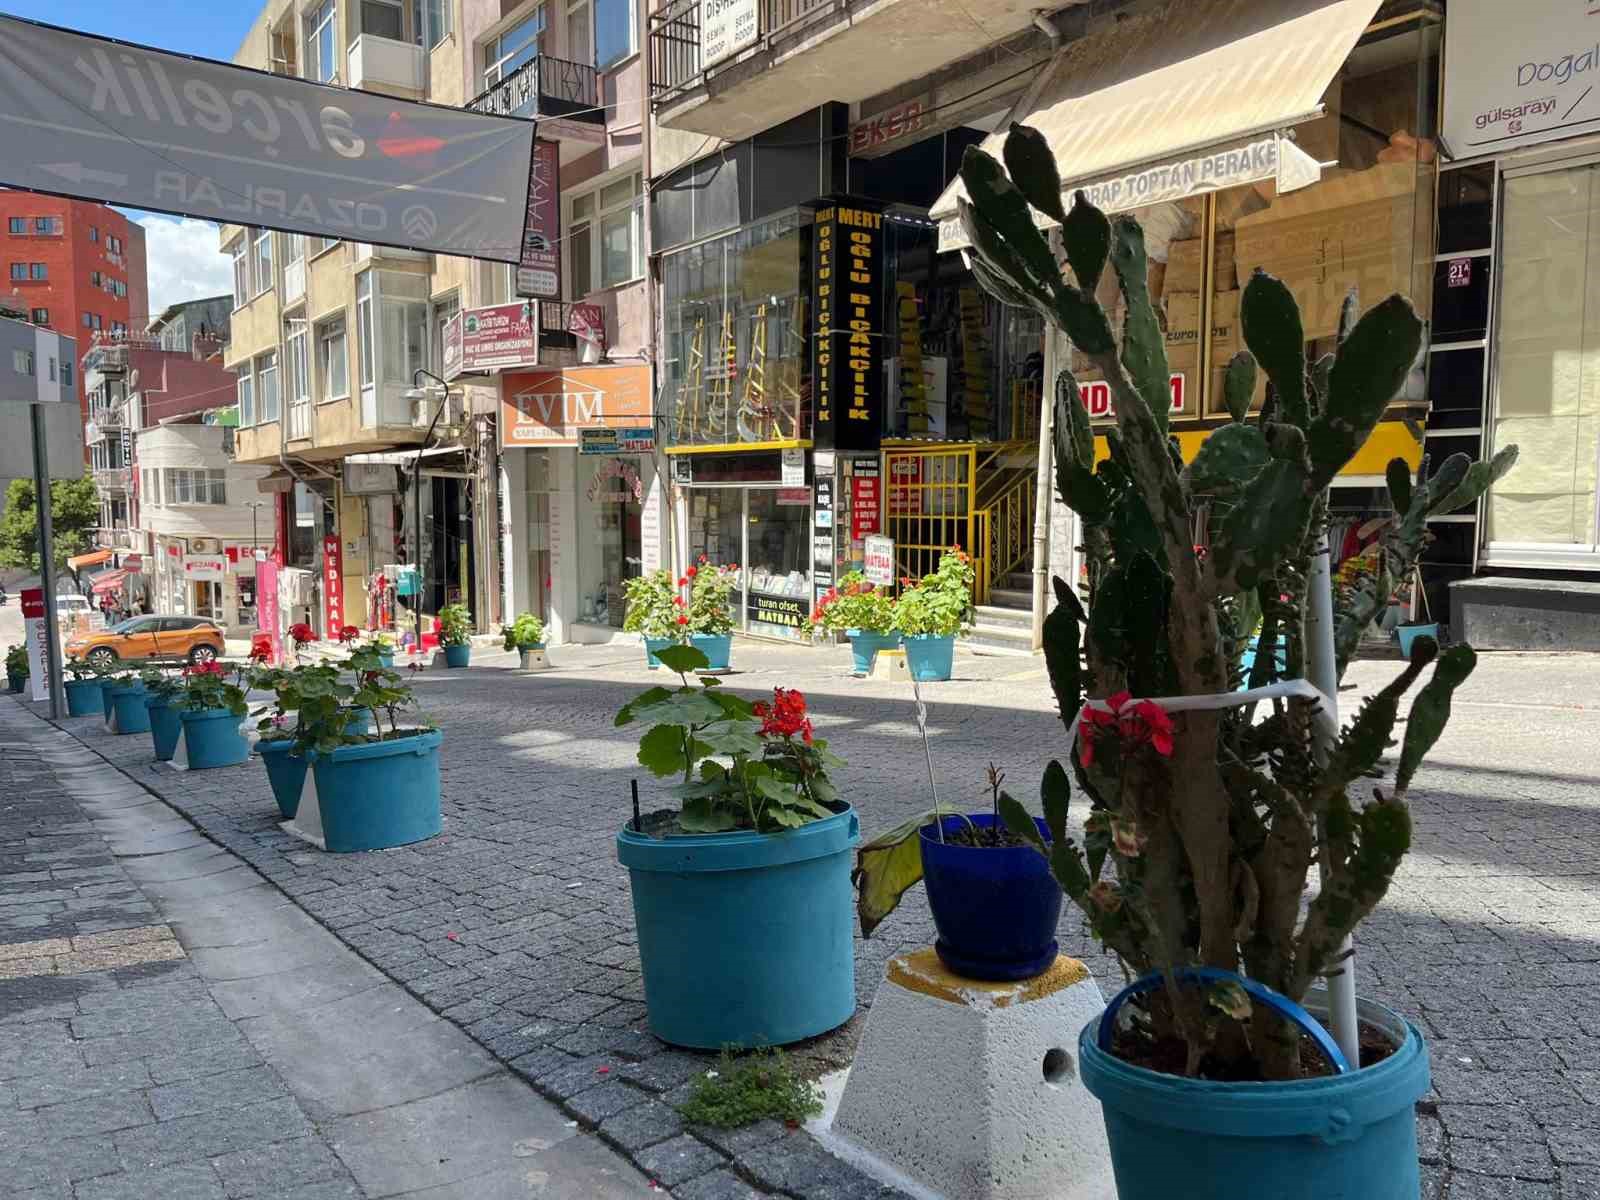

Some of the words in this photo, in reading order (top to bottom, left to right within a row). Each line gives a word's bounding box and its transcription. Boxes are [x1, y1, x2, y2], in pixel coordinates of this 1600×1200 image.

[1126, 168, 1193, 197] TOPTAN
[1201, 142, 1277, 180] PERAKE
[838, 207, 881, 229] MERT
[512, 383, 607, 425] EVİM
[327, 542, 340, 634] MEDİKAL
[758, 598, 777, 610] turan
[758, 612, 798, 627] MATBAA
